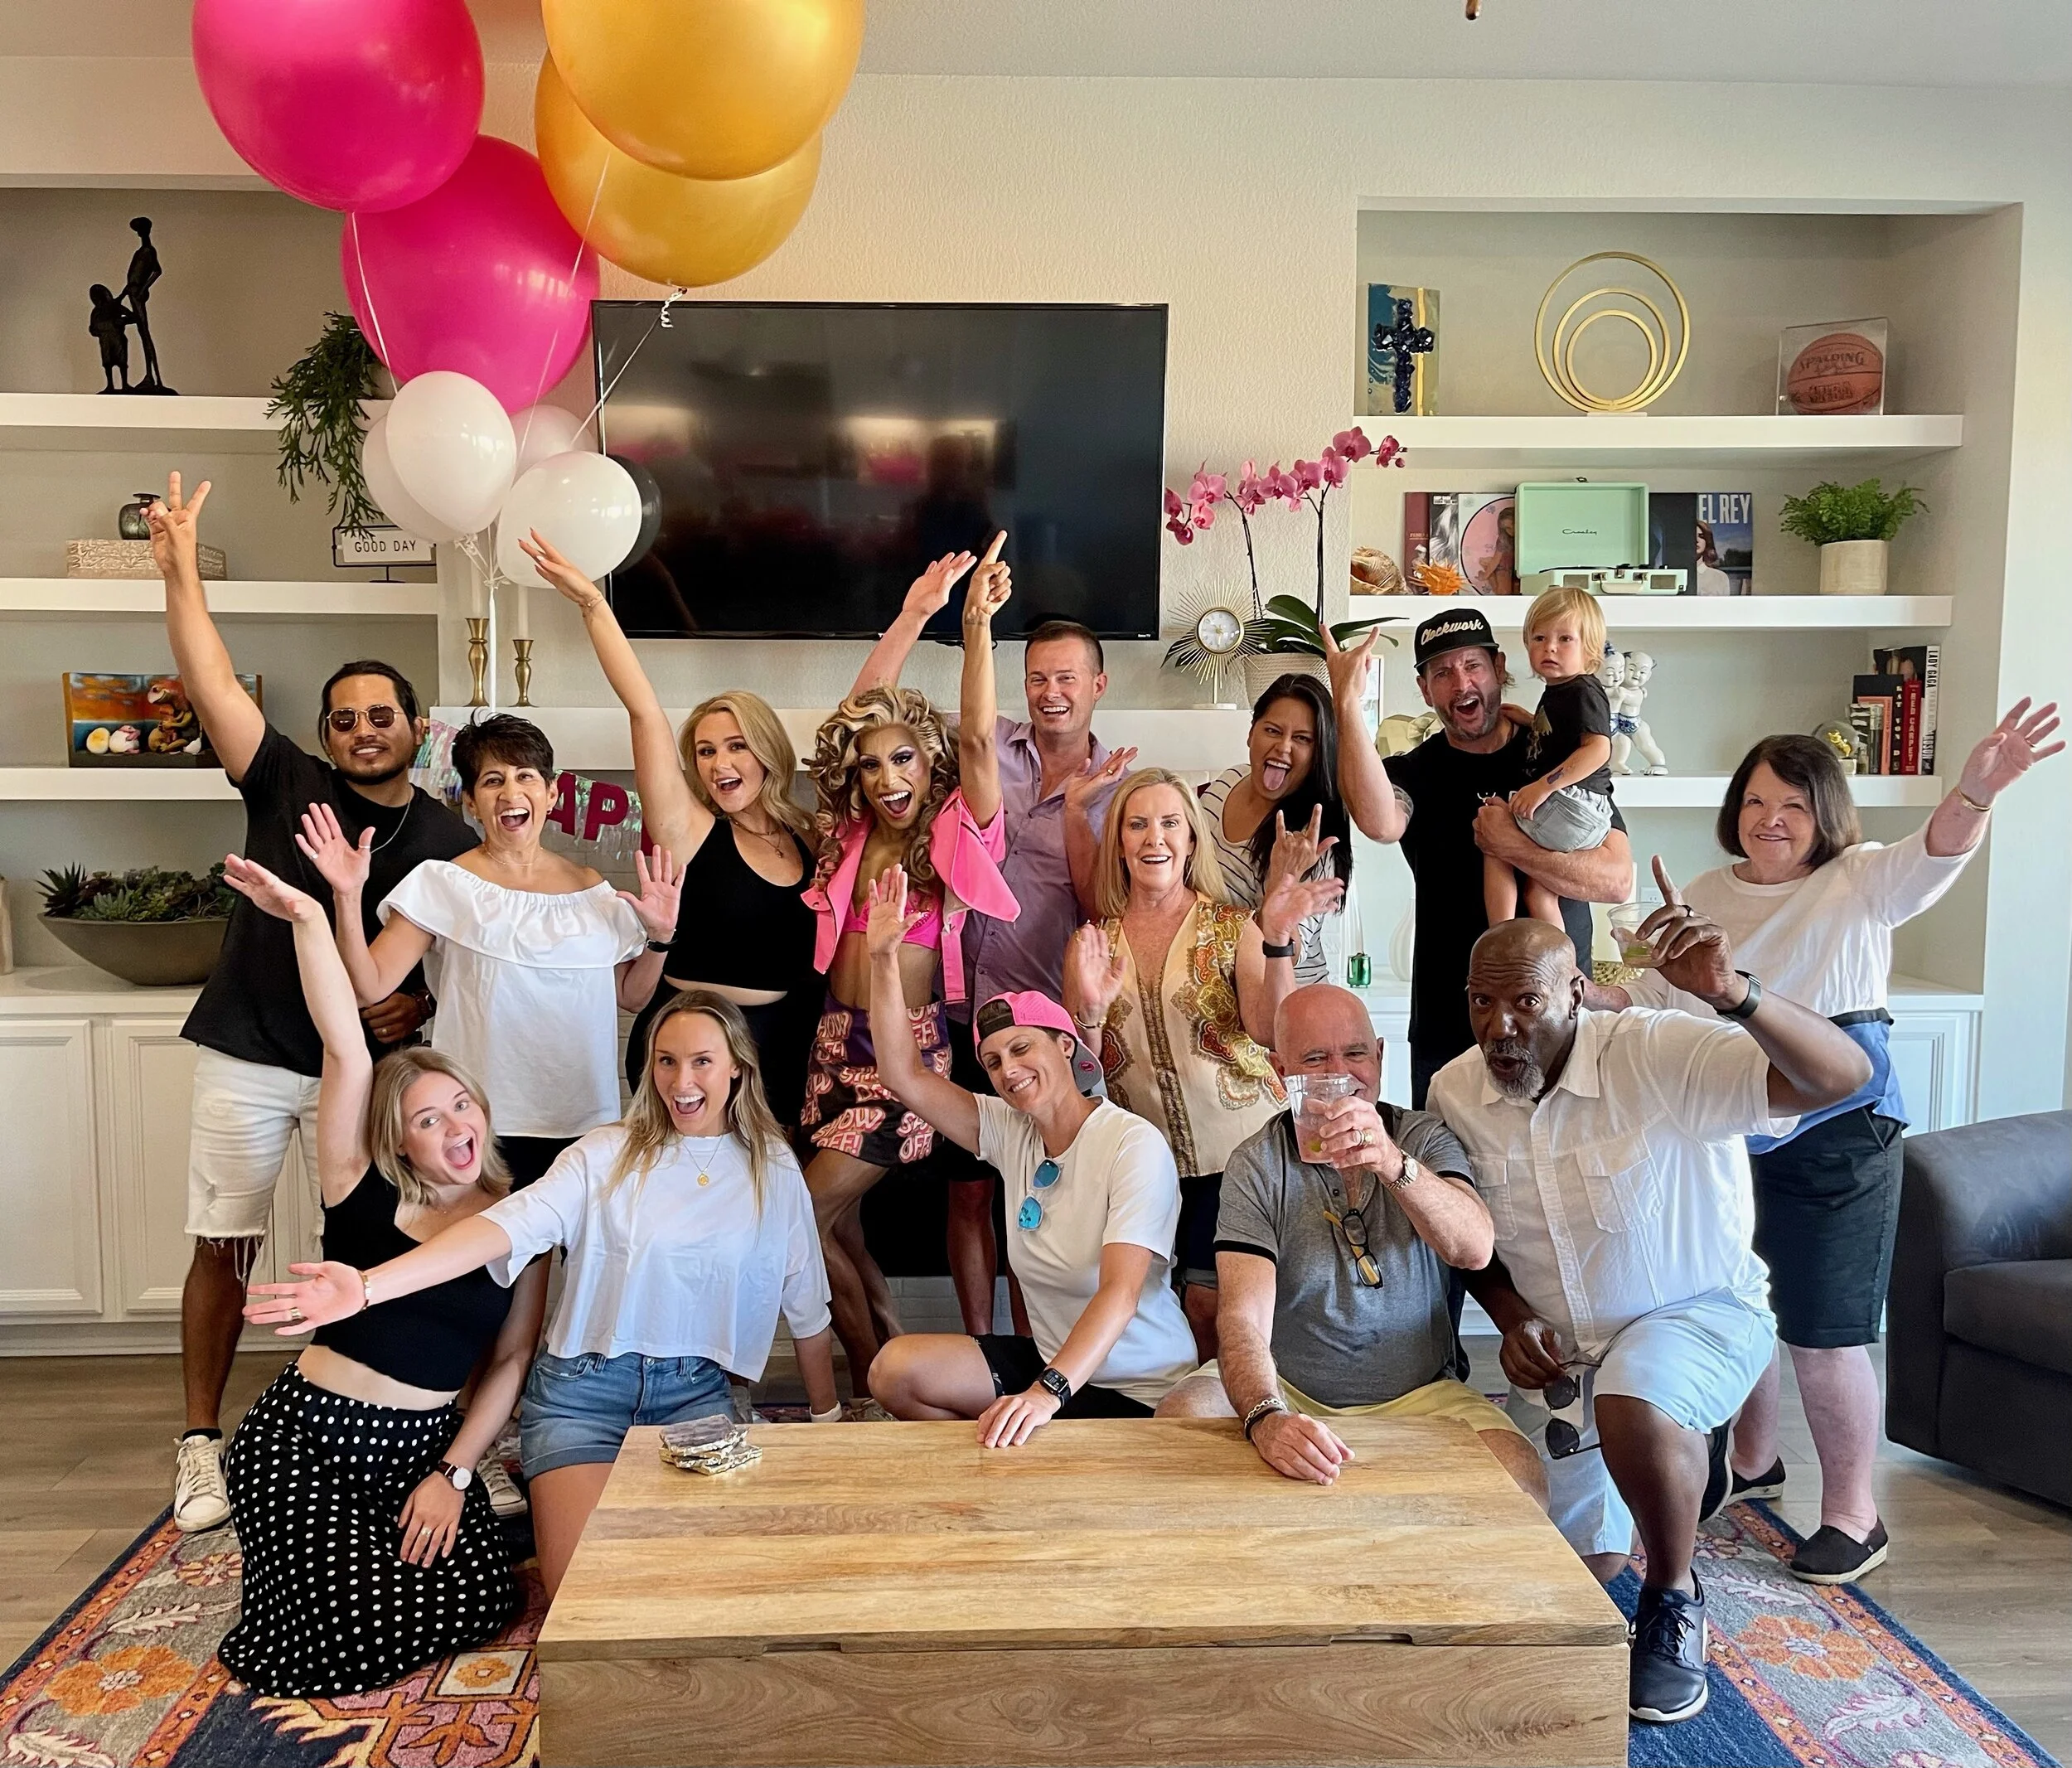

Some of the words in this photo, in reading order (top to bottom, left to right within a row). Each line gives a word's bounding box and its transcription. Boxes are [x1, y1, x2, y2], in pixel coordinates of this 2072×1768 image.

[1698, 495, 1716, 524] EL
[1719, 495, 1750, 524] REY
[355, 541, 386, 552] GOOD
[394, 540, 415, 552] DAY
[1421, 619, 1484, 645] Clockwork
[1928, 650, 1939, 668] LADY
[1926, 670, 1937, 688] GAGA
[811, 1107, 885, 1142] SHOW
[898, 1133, 933, 1161] OFF!
